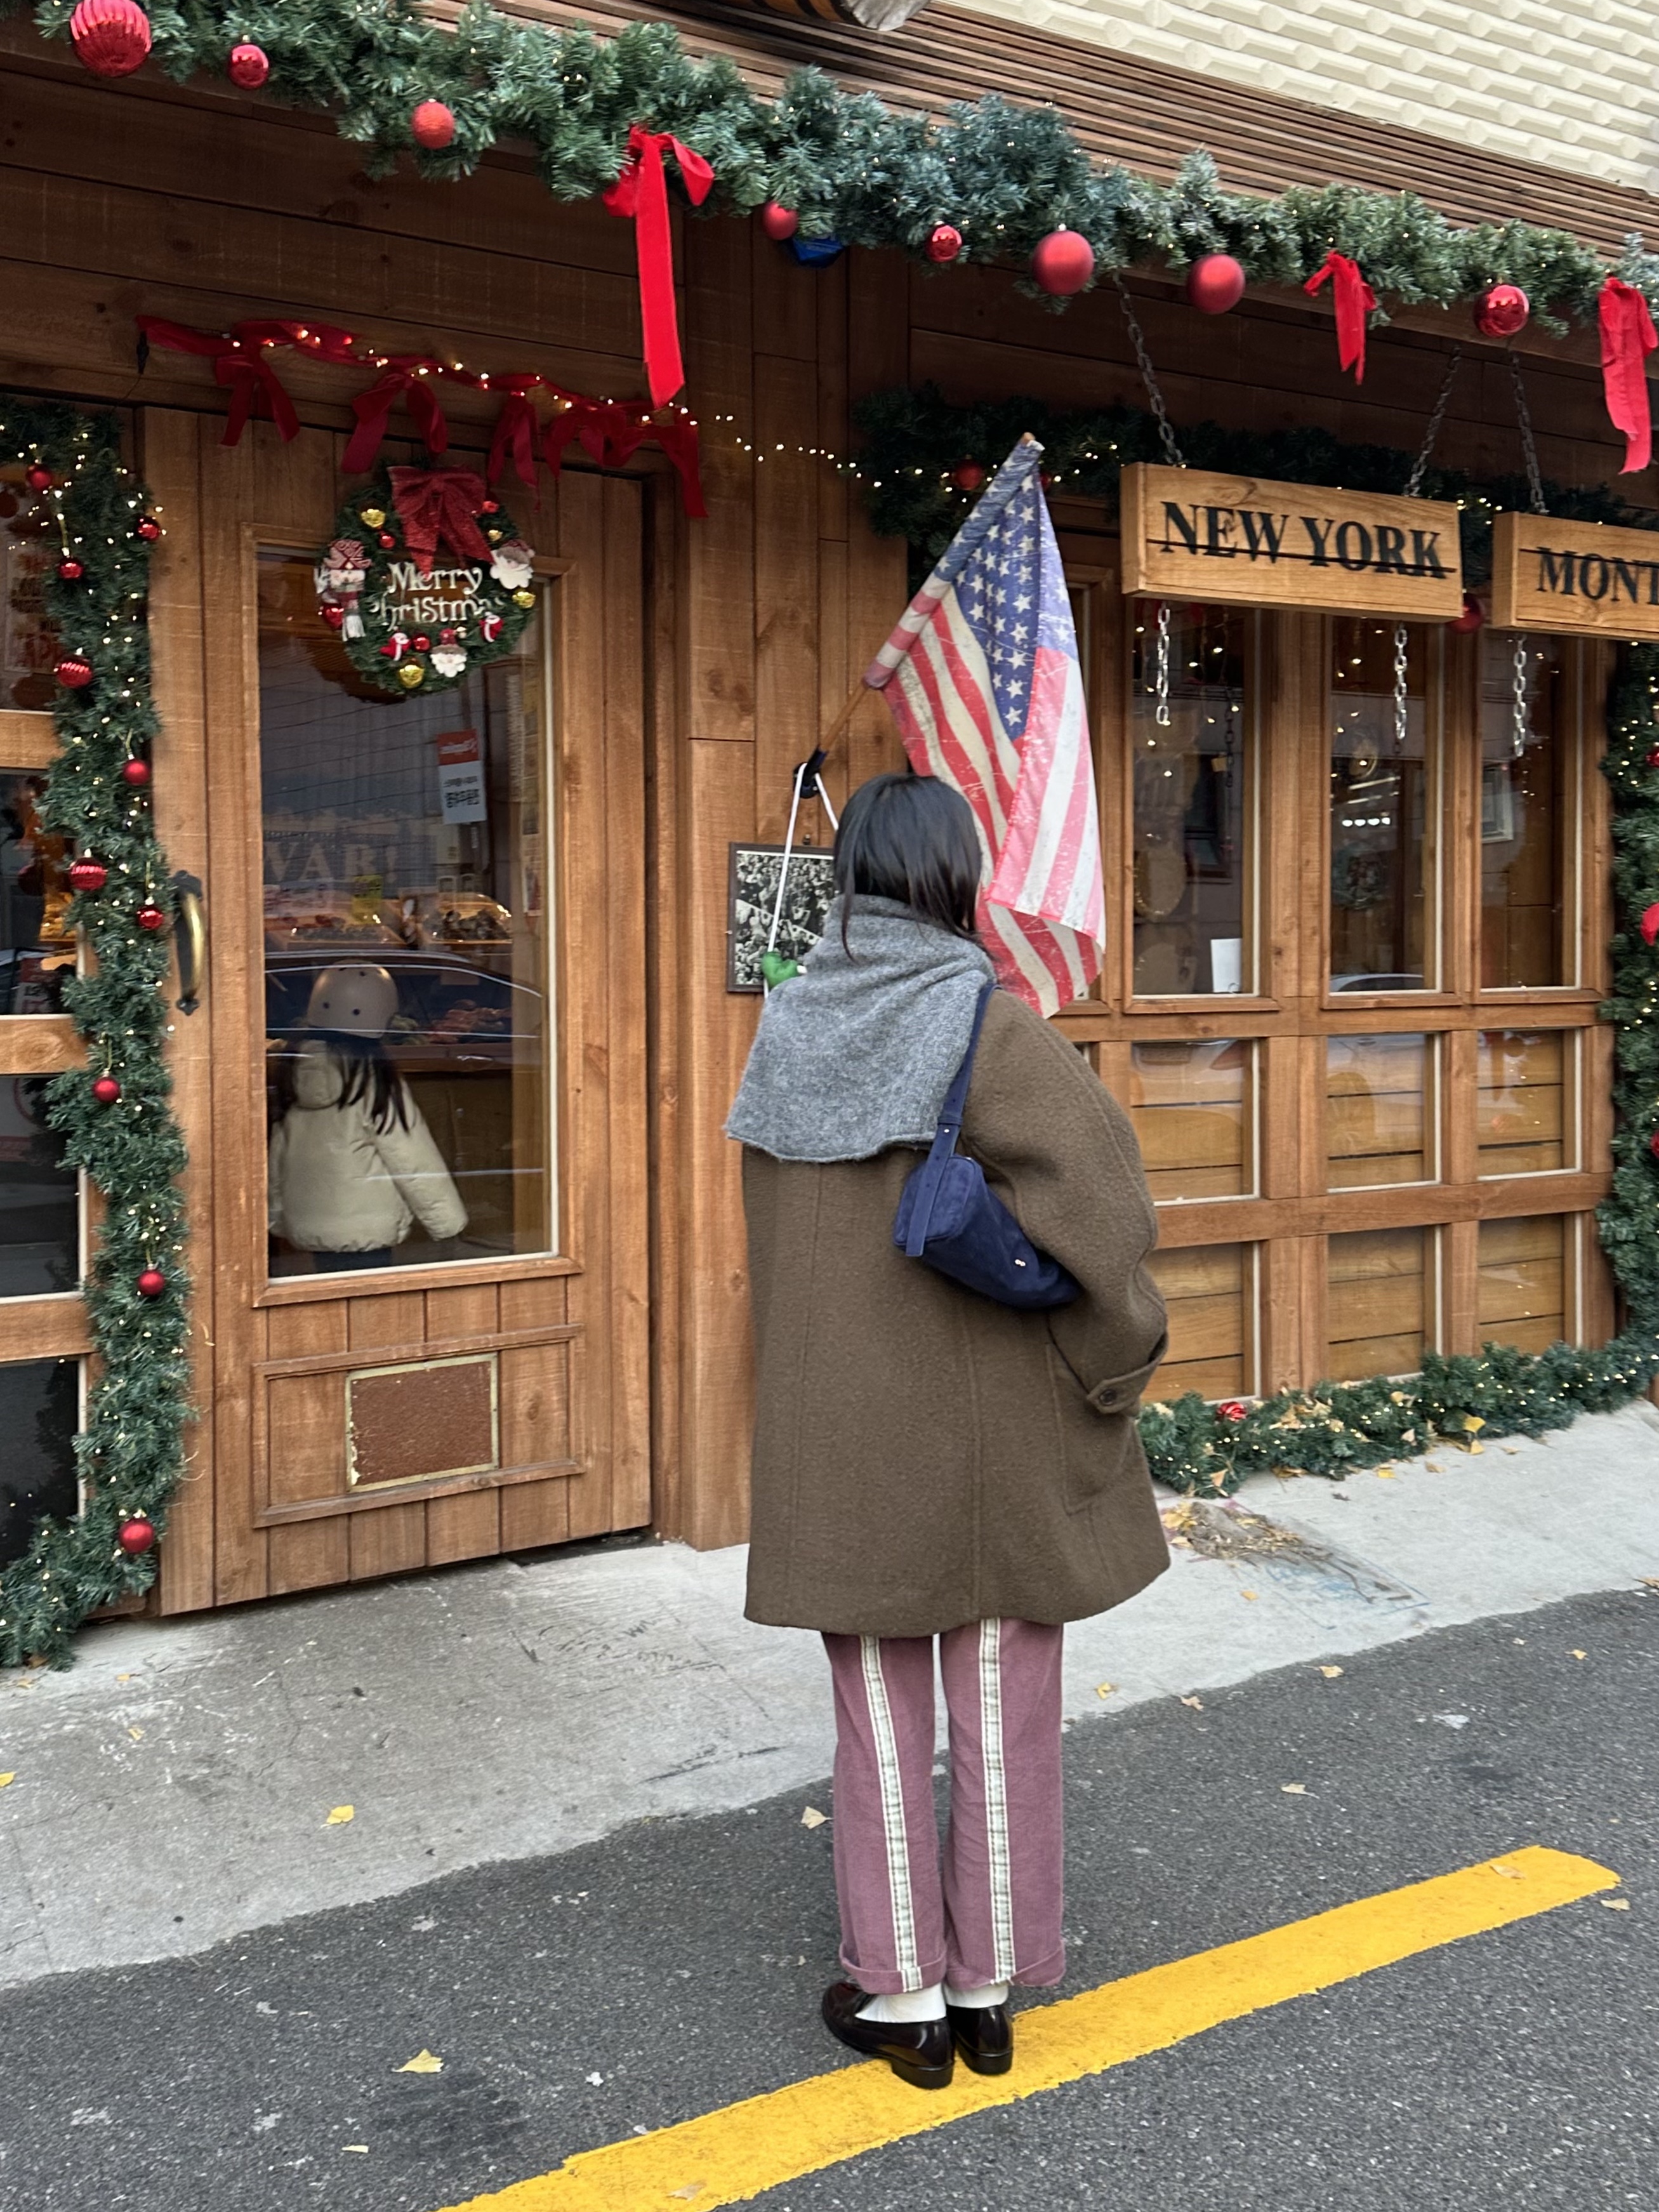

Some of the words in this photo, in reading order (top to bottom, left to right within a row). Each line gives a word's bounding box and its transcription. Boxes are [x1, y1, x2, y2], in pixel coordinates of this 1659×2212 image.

[1161, 501, 1288, 563] NEW
[1300, 517, 1446, 578] YORK
[387, 562, 483, 598] Merry
